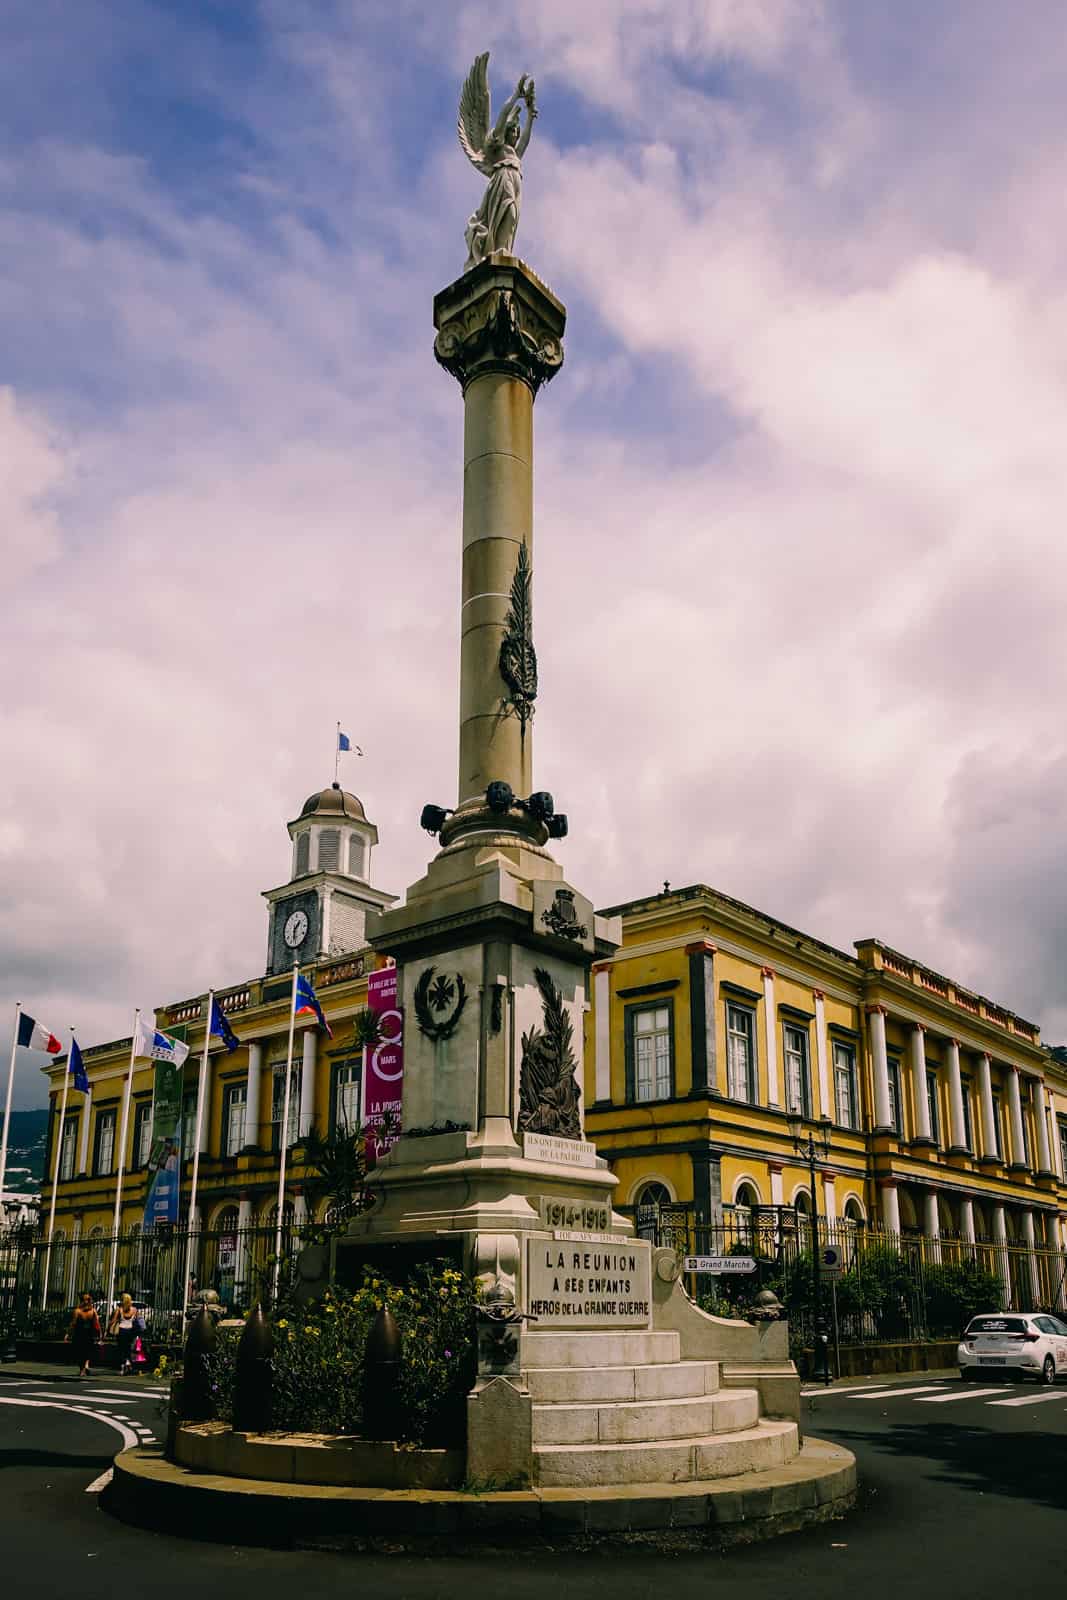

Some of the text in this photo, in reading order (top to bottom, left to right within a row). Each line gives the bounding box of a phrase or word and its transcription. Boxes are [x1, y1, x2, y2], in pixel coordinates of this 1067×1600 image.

[381, 1056, 396, 1064] MARS
[371, 1102, 380, 1113] LA
[547, 1204, 607, 1230] 1914-1918
[546, 1251, 636, 1272] LA REUNION
[700, 1260, 722, 1269] Grand
[553, 1277, 631, 1294] A SES ENFANTS
[531, 1301, 649, 1316] HEROS DE LA GRANDE GUERRE
